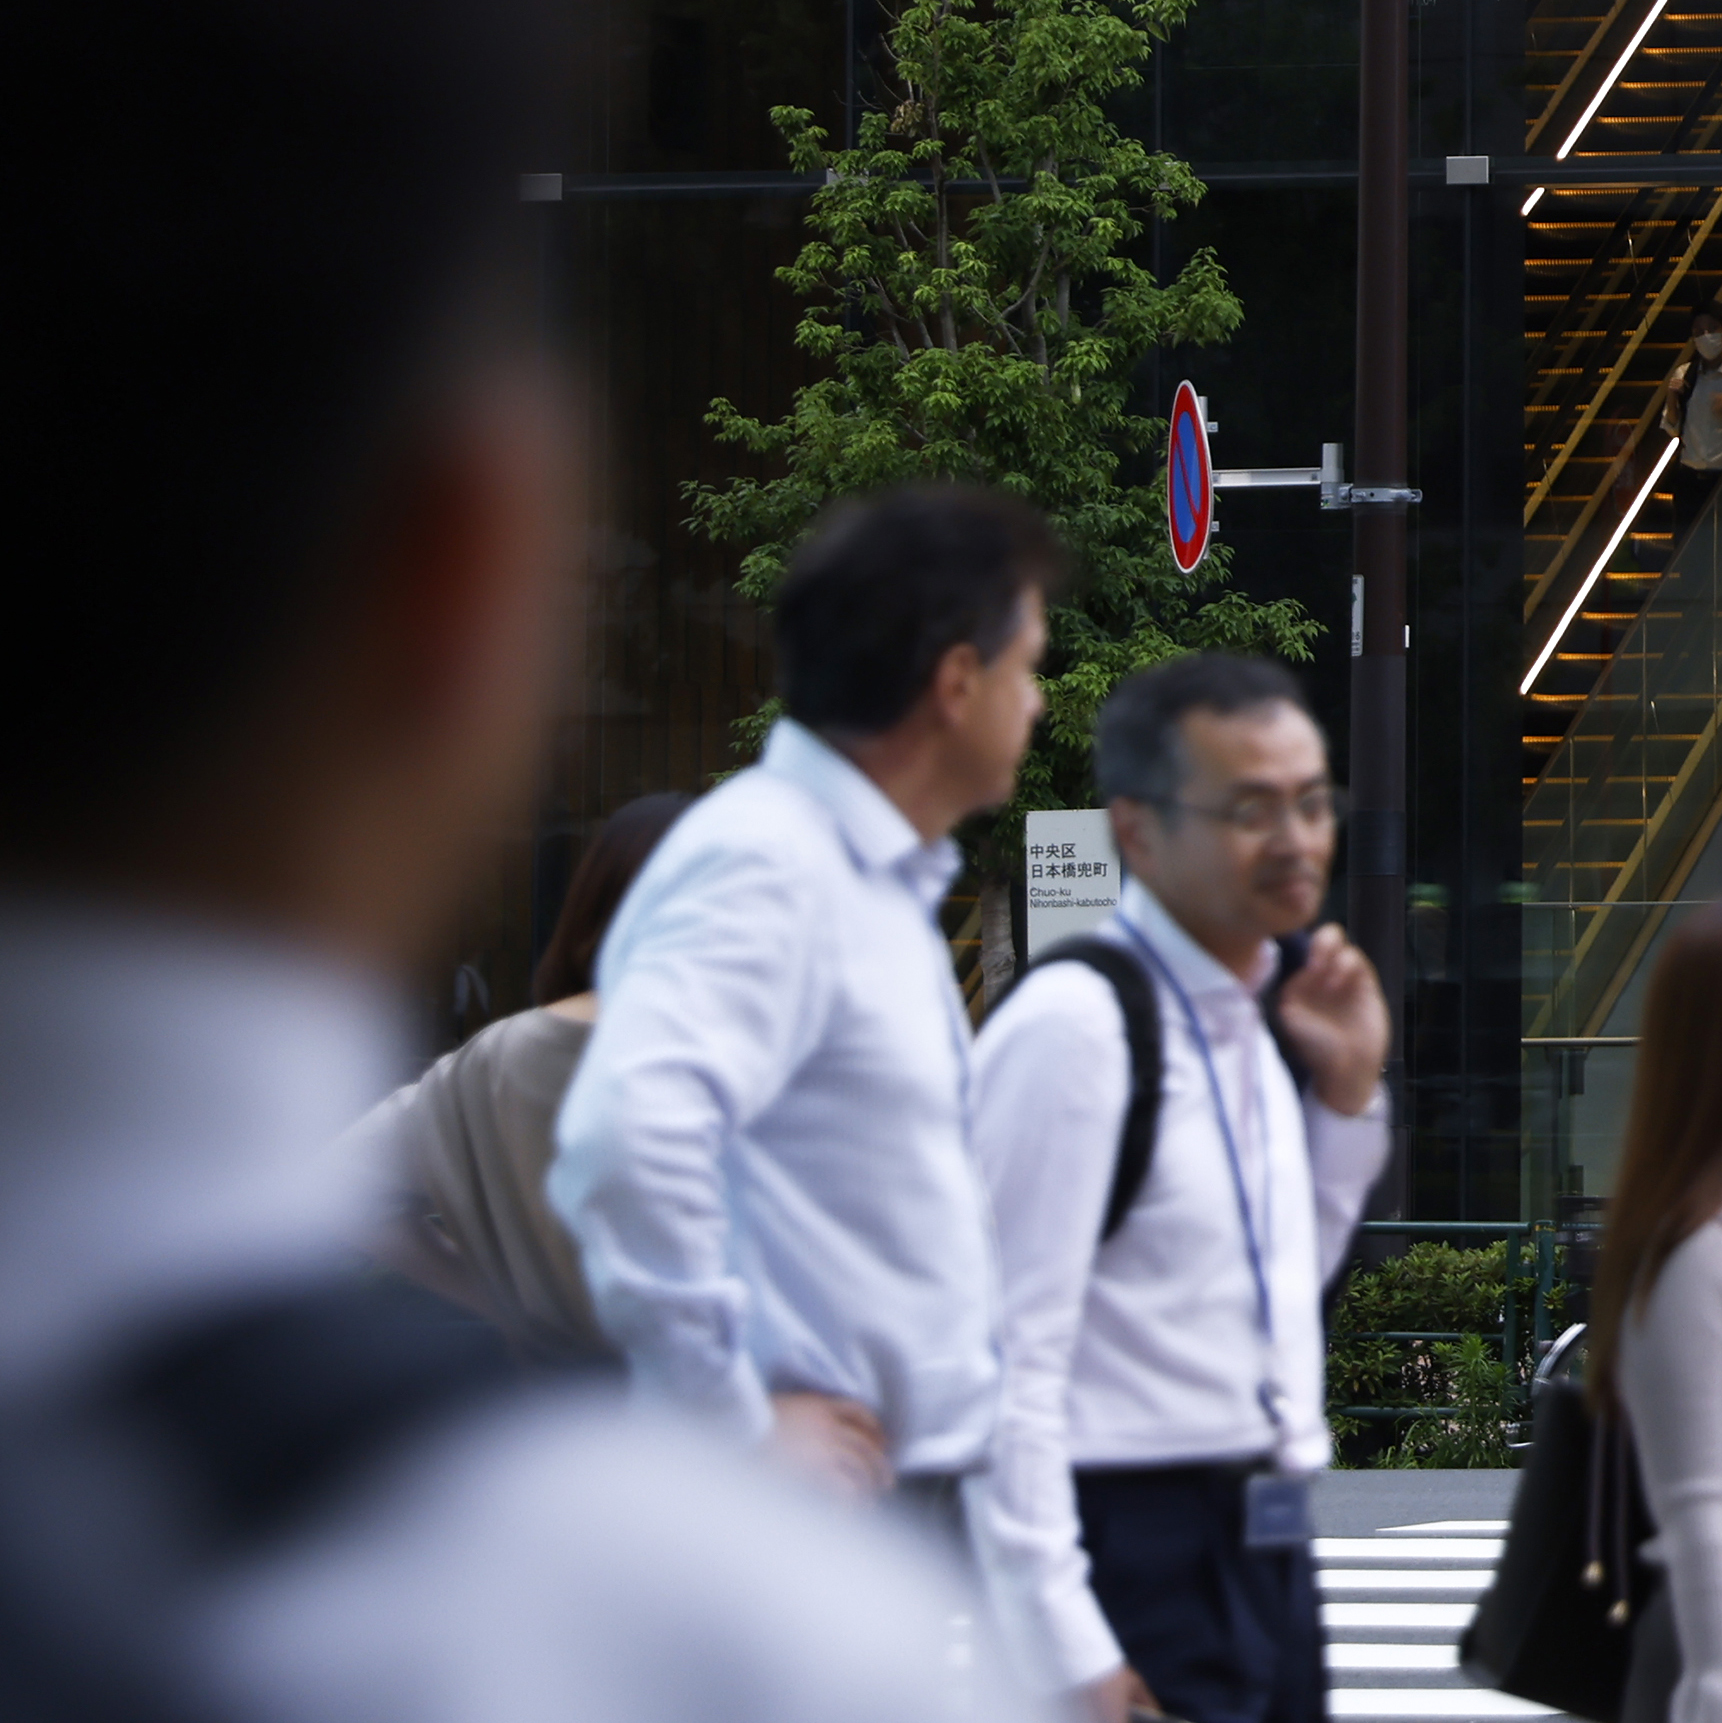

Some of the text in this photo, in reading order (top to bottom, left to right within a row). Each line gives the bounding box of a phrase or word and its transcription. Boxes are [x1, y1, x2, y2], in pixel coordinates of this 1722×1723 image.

[1030, 843, 1076, 859] 中央区
[1031, 862, 1108, 879] 日本橋兜町
[1030, 887, 1071, 897] Chuo-ku
[1029, 898, 1117, 909] Nihonbashi-kabutocho
